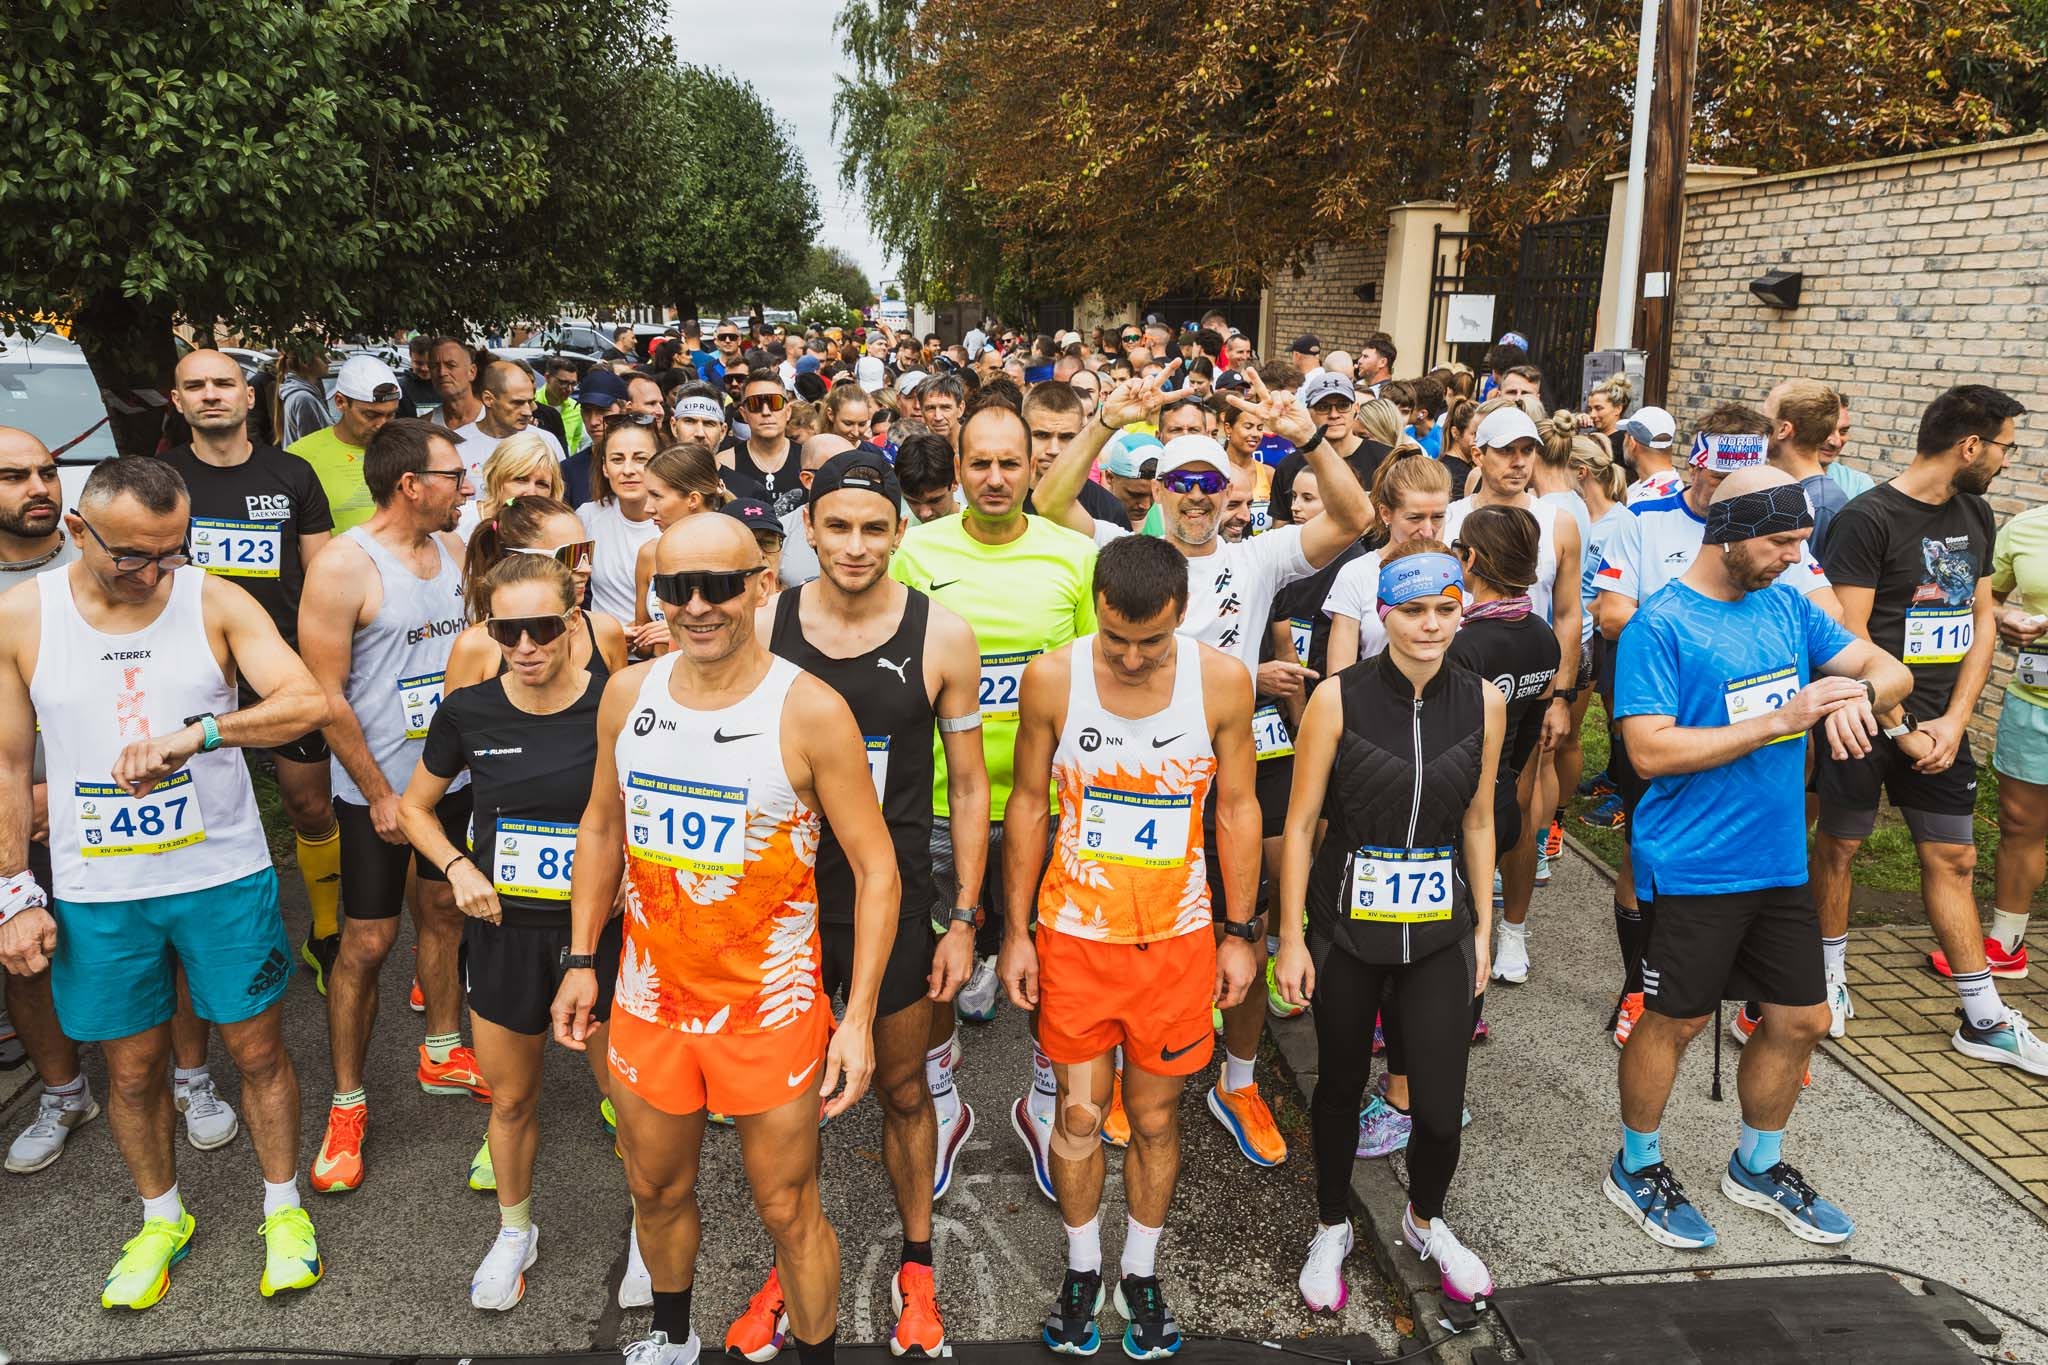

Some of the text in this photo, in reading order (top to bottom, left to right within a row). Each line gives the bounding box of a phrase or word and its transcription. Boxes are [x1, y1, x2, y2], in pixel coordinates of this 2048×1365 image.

[684, 402, 718, 413] KIPRUN
[1718, 435, 1763, 446] NORDIC
[1718, 445, 1763, 453] WALKING
[1716, 459, 1736, 467] CUP
[1717, 451, 1759, 460] WORLD
[218, 537, 275, 564] 123
[1932, 624, 1970, 649] 110
[114, 650, 151, 660] TERREX
[1519, 668, 1556, 687] CROSSFIT
[979, 675, 1019, 705] 22
[659, 719, 677, 731] NN
[1265, 721, 1288, 745] 18
[1106, 737, 1123, 746] NN
[110, 797, 188, 838] 487
[659, 807, 735, 853] 197
[1134, 819, 1158, 850] 4
[1385, 871, 1446, 904] 173
